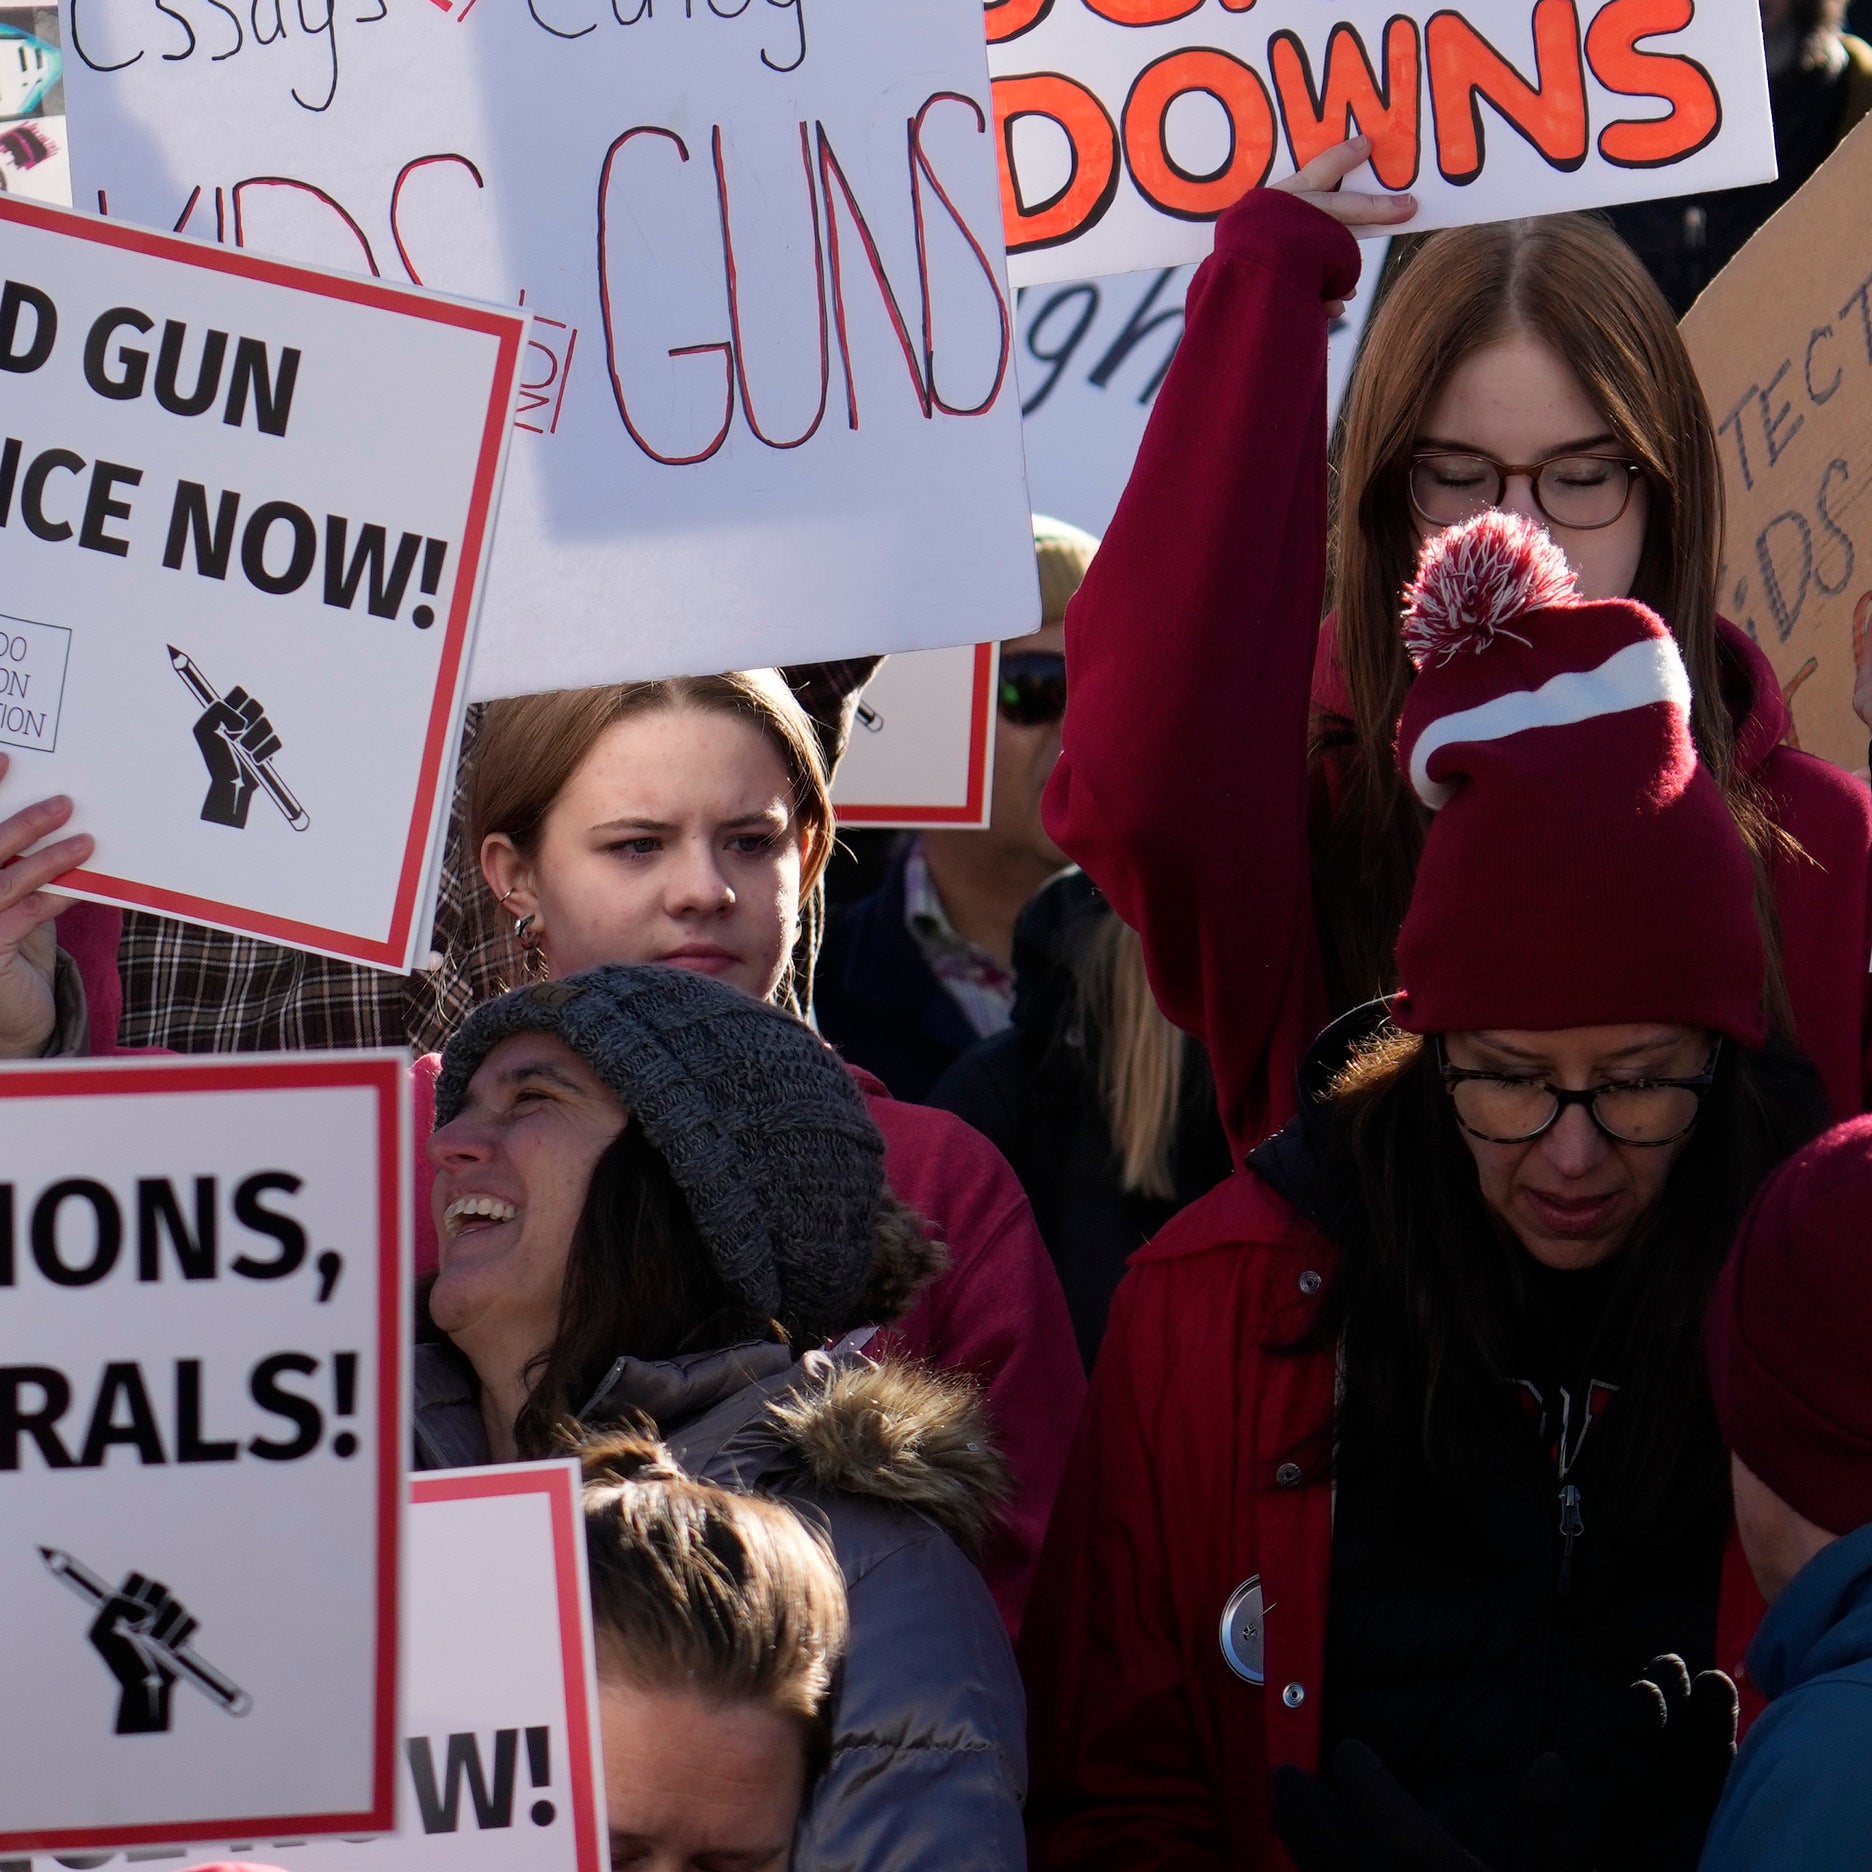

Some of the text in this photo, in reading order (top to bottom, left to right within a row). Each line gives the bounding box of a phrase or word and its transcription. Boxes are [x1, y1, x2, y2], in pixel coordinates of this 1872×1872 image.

[597, 90, 1012, 467] GUNS
[82, 307, 302, 439] GUN
[161, 479, 450, 632] NOW!
